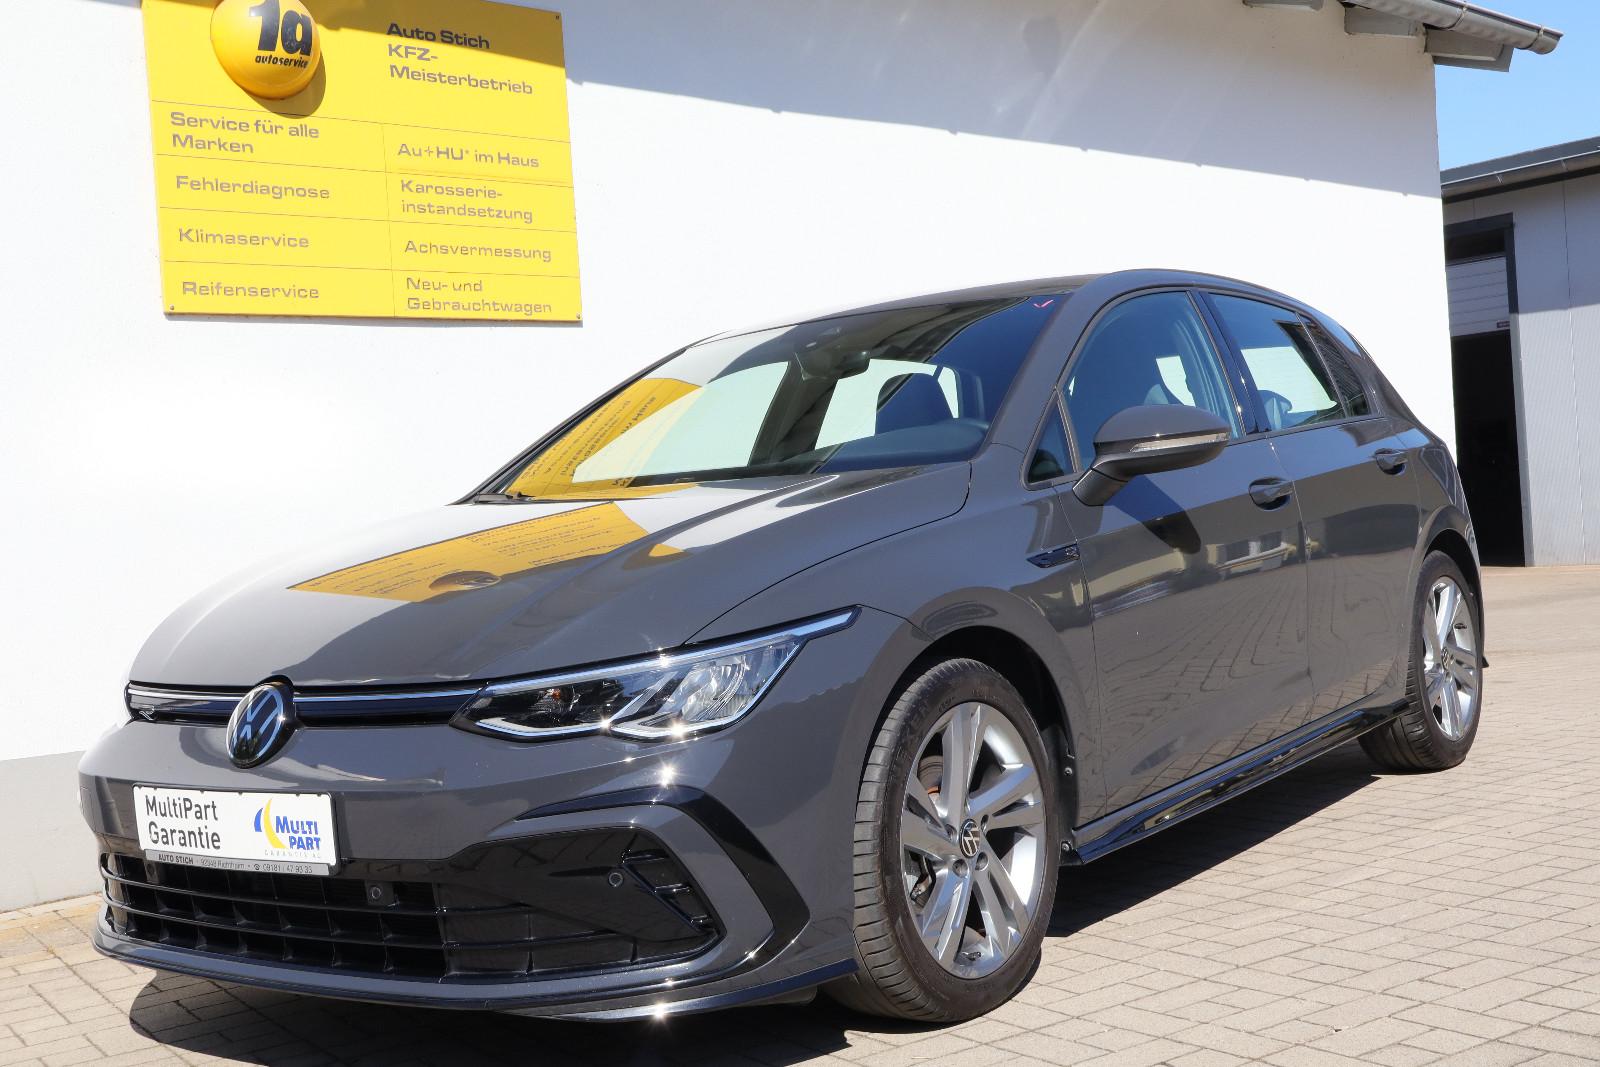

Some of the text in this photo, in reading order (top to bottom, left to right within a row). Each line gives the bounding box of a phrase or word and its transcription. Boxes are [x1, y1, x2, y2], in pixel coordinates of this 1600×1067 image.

[250, 0, 313, 56] 1a
[386, 22, 490, 49] Auto Stich
[255, 54, 309, 69] autoservice
[388, 43, 438, 61] KFZ-
[389, 64, 533, 94] Meisterbetrieb
[170, 111, 320, 138] Service für alle
[172, 133, 254, 153] Marken
[474, 150, 494, 164] im
[497, 152, 540, 168] Haus
[176, 175, 331, 200] Fehlerdiagnose
[401, 179, 503, 199] Karosserie-
[401, 200, 533, 224] instandsetzung
[178, 228, 310, 248] Klimaservice
[404, 240, 551, 263] Achsvermessung
[182, 281, 320, 299] Reifenservice
[406, 277, 483, 292] Neu- und
[407, 297, 552, 316] Gebrauchtwagen
[145, 795, 218, 821] MultiPart
[275, 815, 319, 835] MULTI
[148, 821, 221, 850] Garantie
[288, 835, 321, 850] PART
[158, 854, 174, 862] AUTO
[175, 856, 194, 864] STICH
